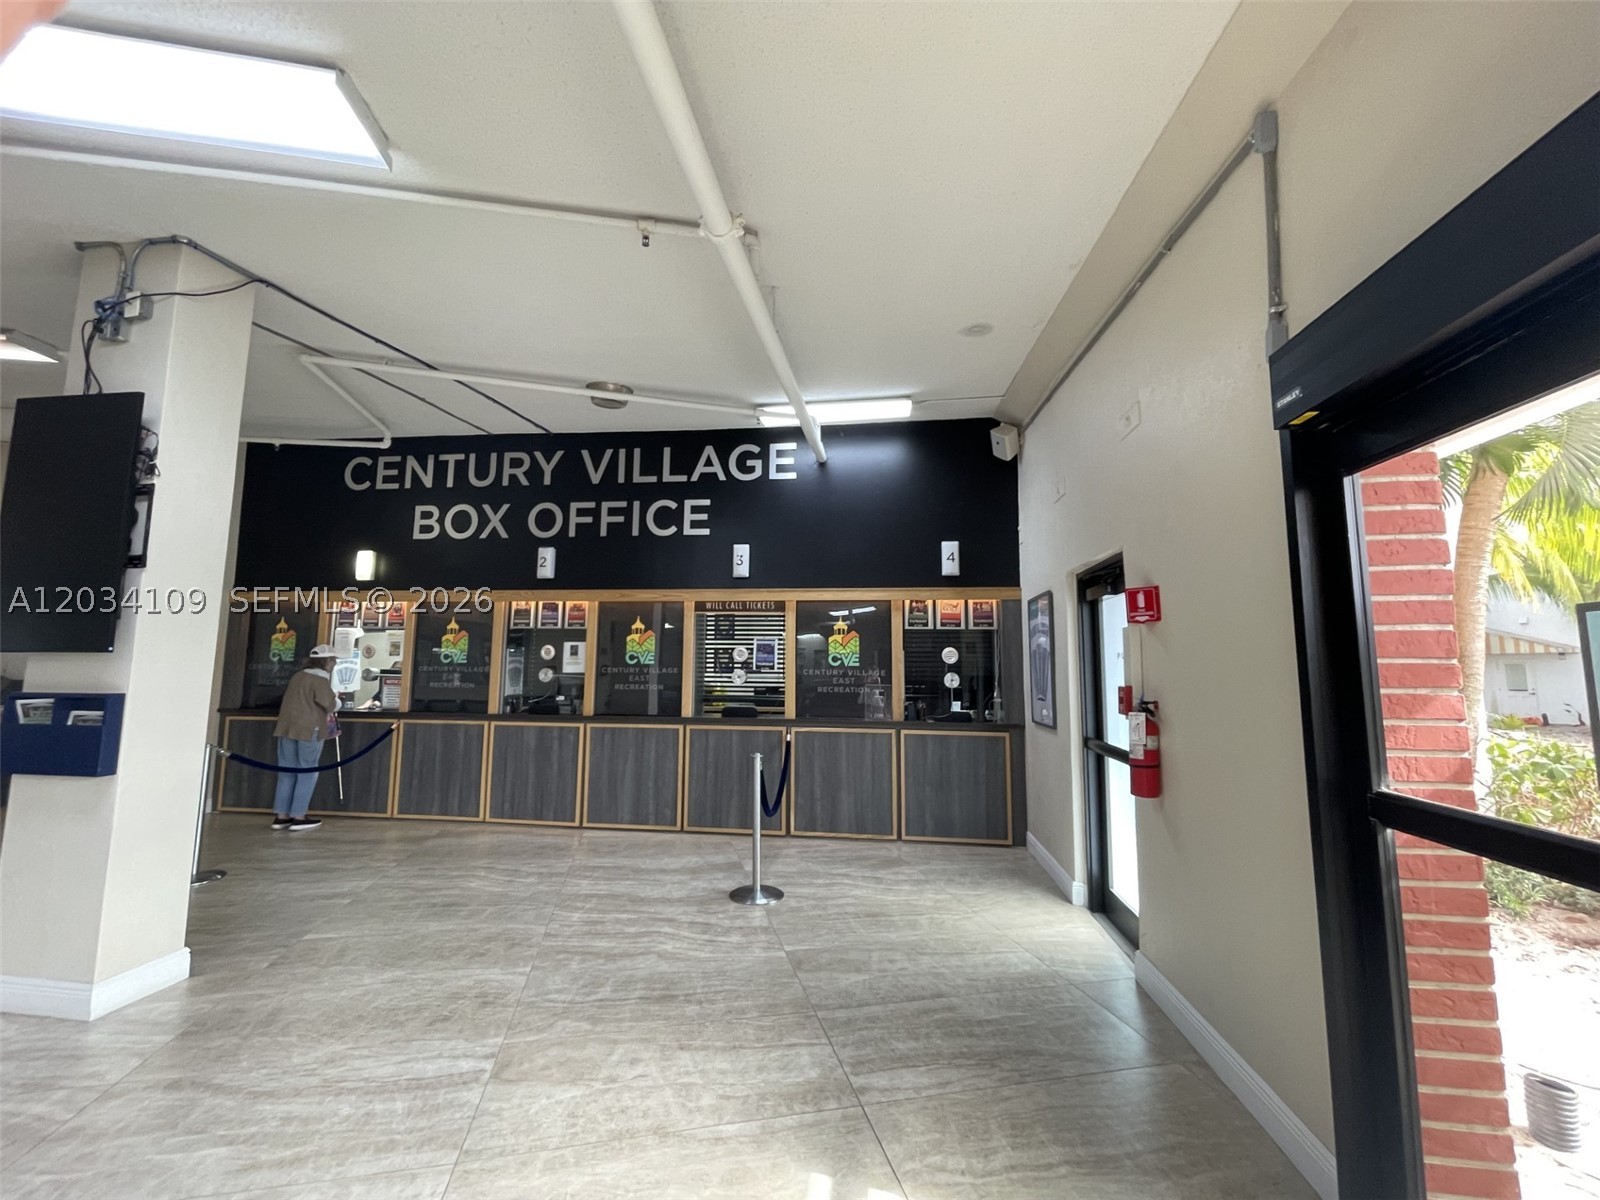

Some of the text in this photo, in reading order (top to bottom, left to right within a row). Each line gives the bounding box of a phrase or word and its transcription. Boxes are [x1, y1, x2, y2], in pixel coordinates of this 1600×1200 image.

[343, 442, 798, 492] CENTURY VILLAGE
[412, 498, 711, 540] BOX OFFICE
[539, 556, 547, 567] 2
[736, 555, 744, 566] 3
[946, 552, 956, 563] 4
[705, 601, 776, 610] WILL CALL TICKETS
[269, 650, 295, 662] CVE
[440, 650, 468, 663] CVE
[625, 651, 655, 665] CVE
[828, 653, 860, 667] CVE
[601, 666, 640, 674] CENTURY
[802, 668, 886, 677] CENTURY VILLAGE
